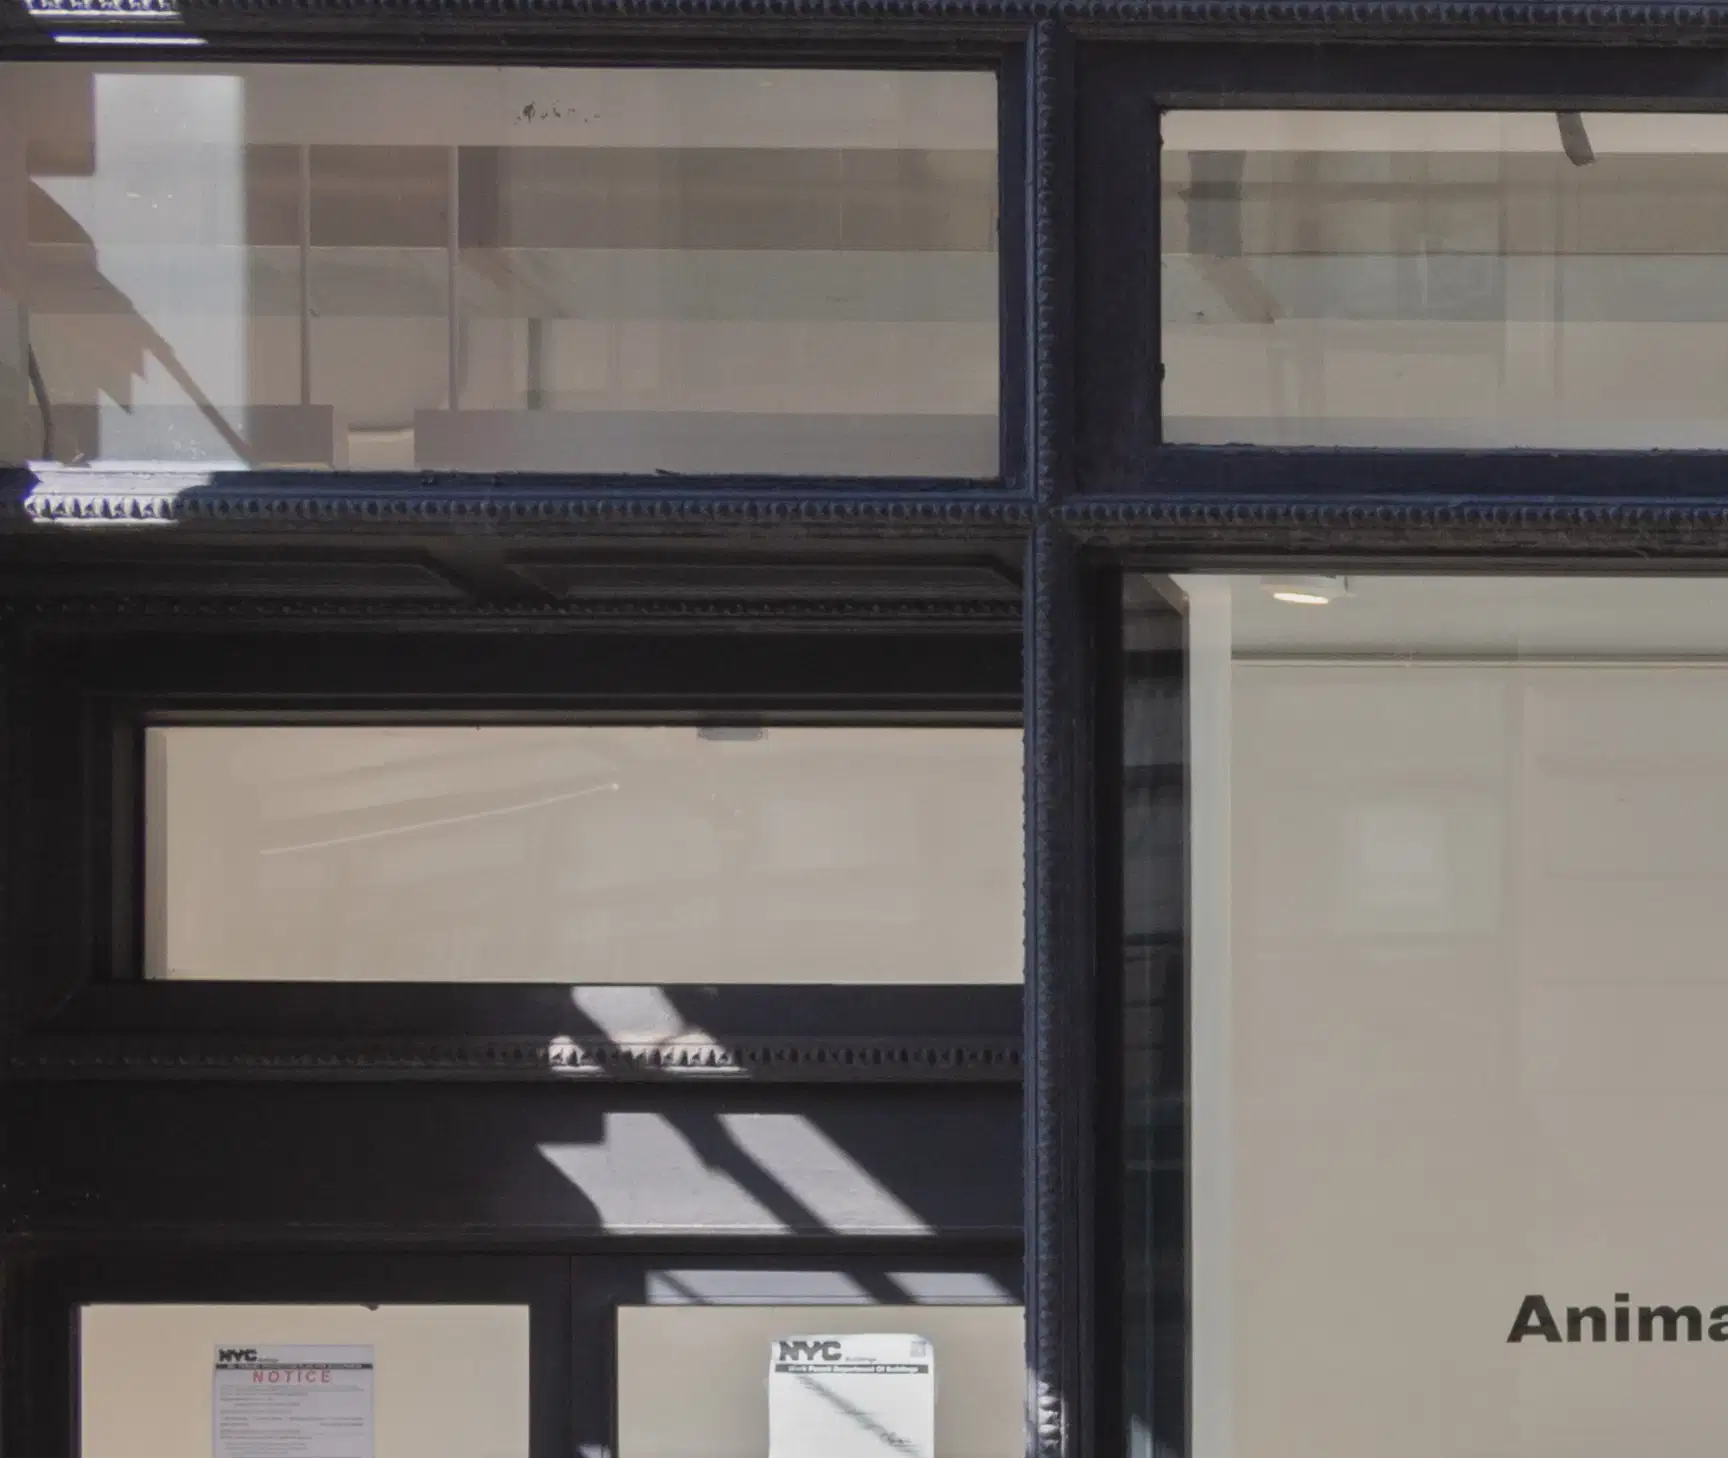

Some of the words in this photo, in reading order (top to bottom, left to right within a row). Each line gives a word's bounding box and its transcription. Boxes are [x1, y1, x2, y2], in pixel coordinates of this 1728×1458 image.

[219, 1349, 257, 1362] NYC
[780, 1341, 841, 1361] NYC
[252, 1370, 331, 1383] NOTICE
